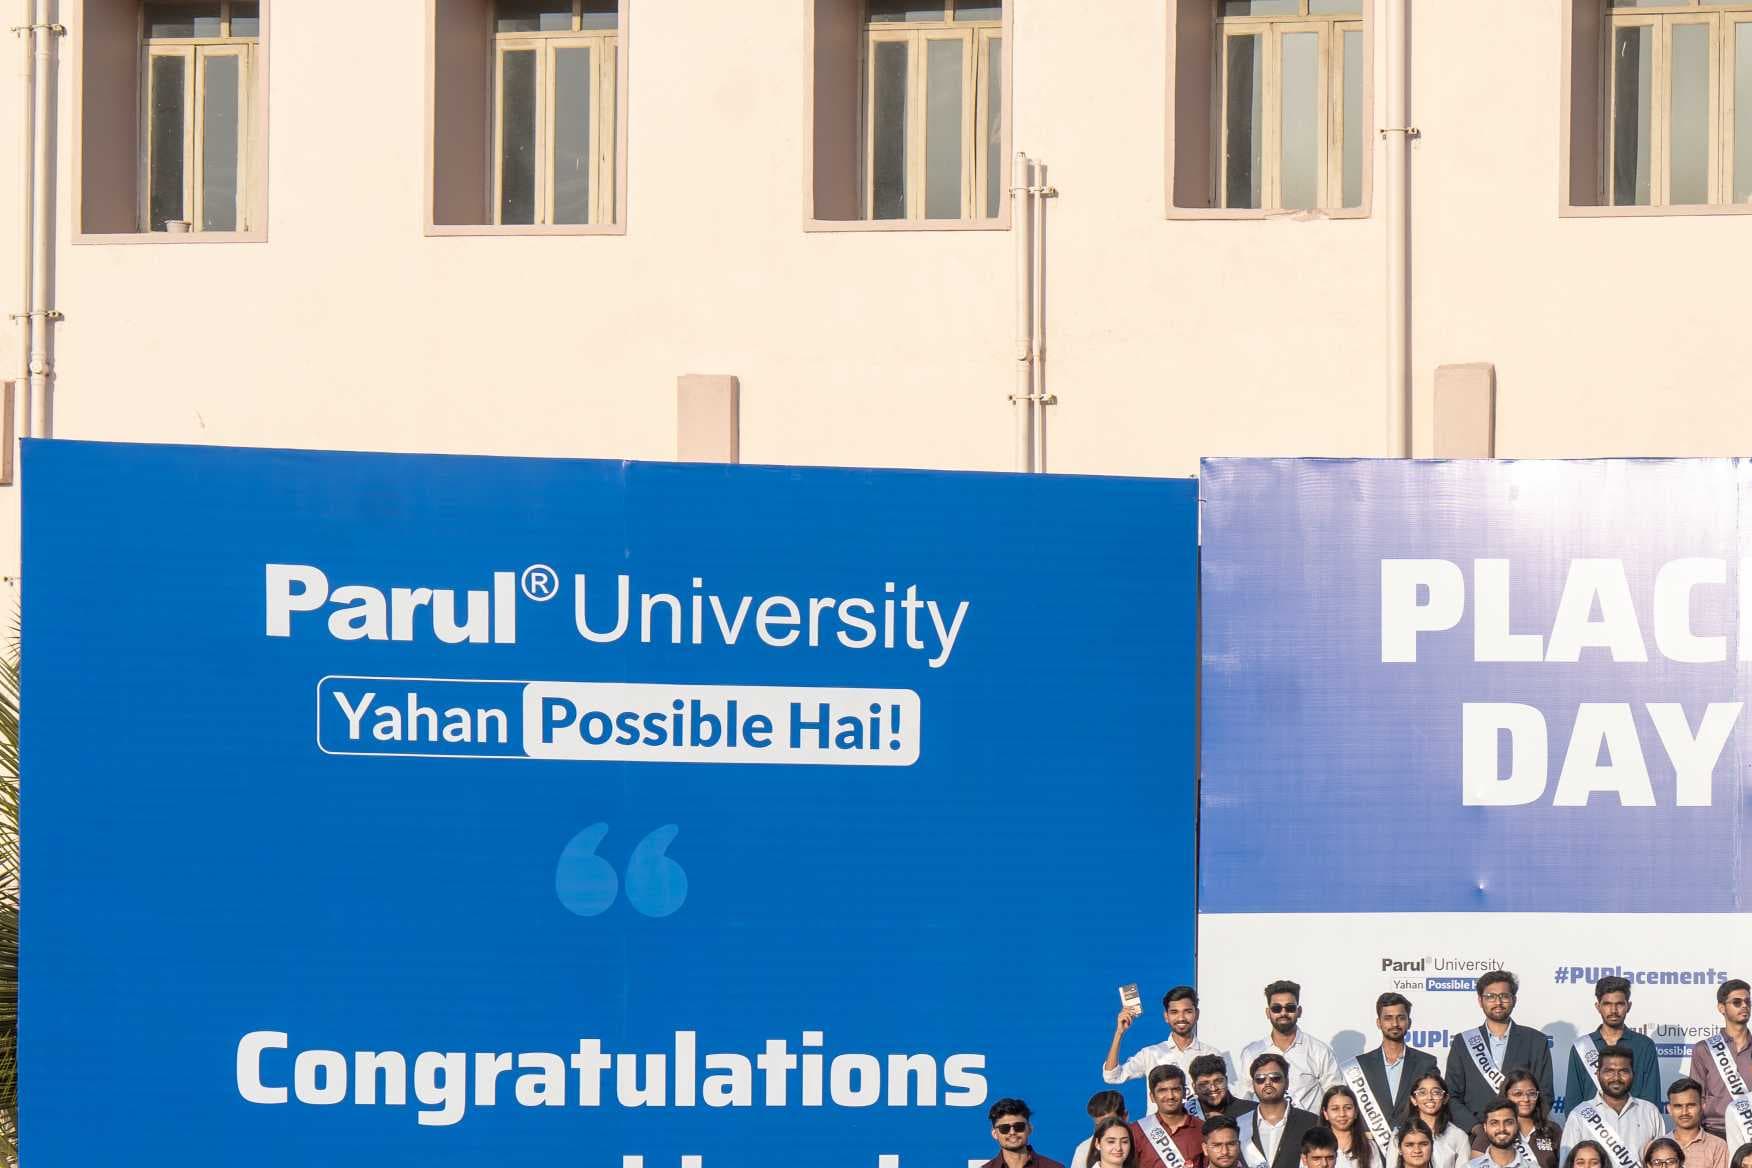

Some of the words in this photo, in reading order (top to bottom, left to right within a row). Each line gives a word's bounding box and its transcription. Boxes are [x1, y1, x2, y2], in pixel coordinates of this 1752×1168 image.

[574, 573, 970, 669] University
[333, 691, 508, 744] Yahan
[541, 696, 773, 749] Possible
[789, 702, 902, 751] Hai!
[1462, 702, 1745, 806] DAY
[1393, 979, 1424, 990] Yahan
[1428, 979, 1470, 990] Possible
[1434, 958, 1505, 973] University
[236, 1030, 988, 1126] Congratulations
[1655, 1045, 1693, 1056] ossible
